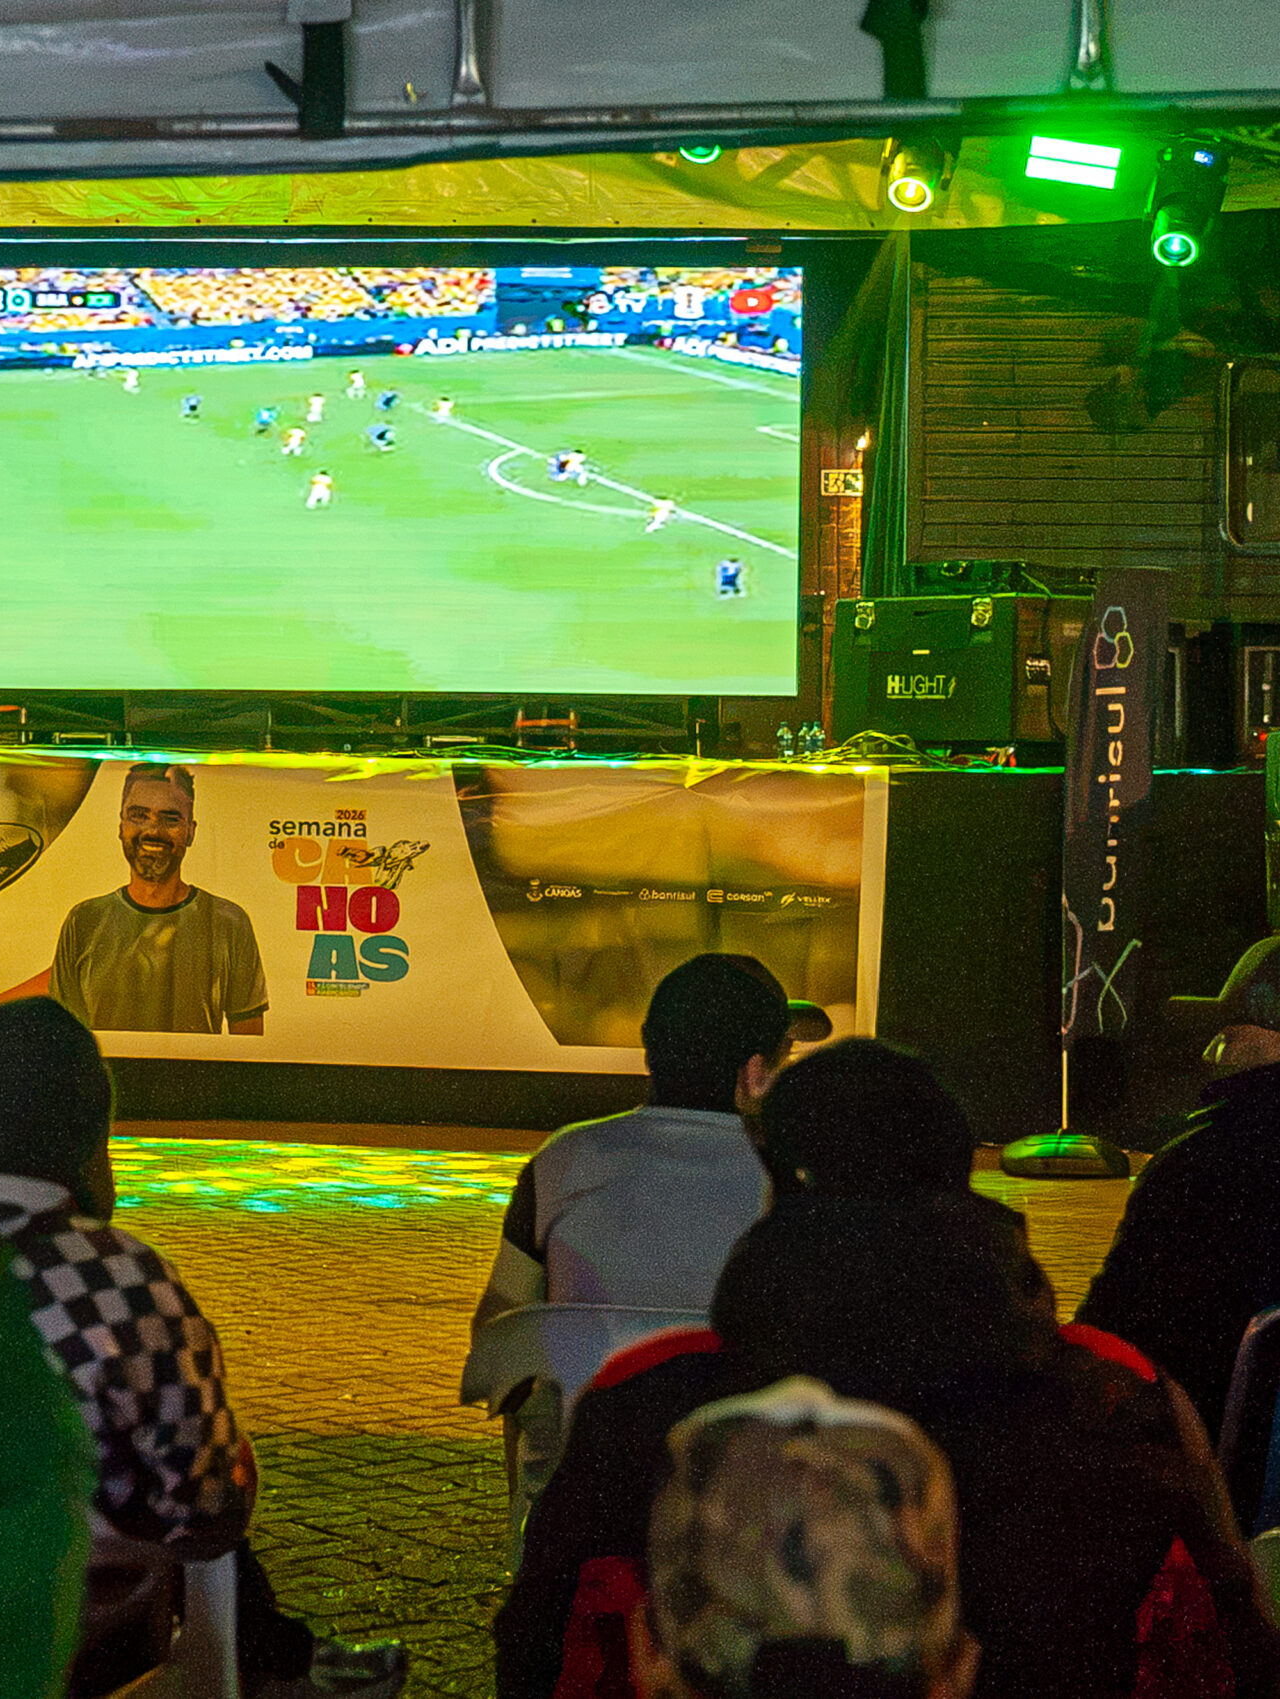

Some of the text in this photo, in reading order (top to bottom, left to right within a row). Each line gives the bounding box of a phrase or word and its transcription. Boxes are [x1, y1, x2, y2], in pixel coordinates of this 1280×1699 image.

[415, 335, 470, 355] ADI
[336, 810, 366, 820] 2026
[269, 820, 367, 838] semana
[268, 838, 285, 850] de
[272, 837, 375, 885] CA
[544, 887, 583, 898] CANOAS
[651, 890, 696, 901] banrisul
[296, 885, 401, 934] NO
[306, 934, 410, 983] AS
